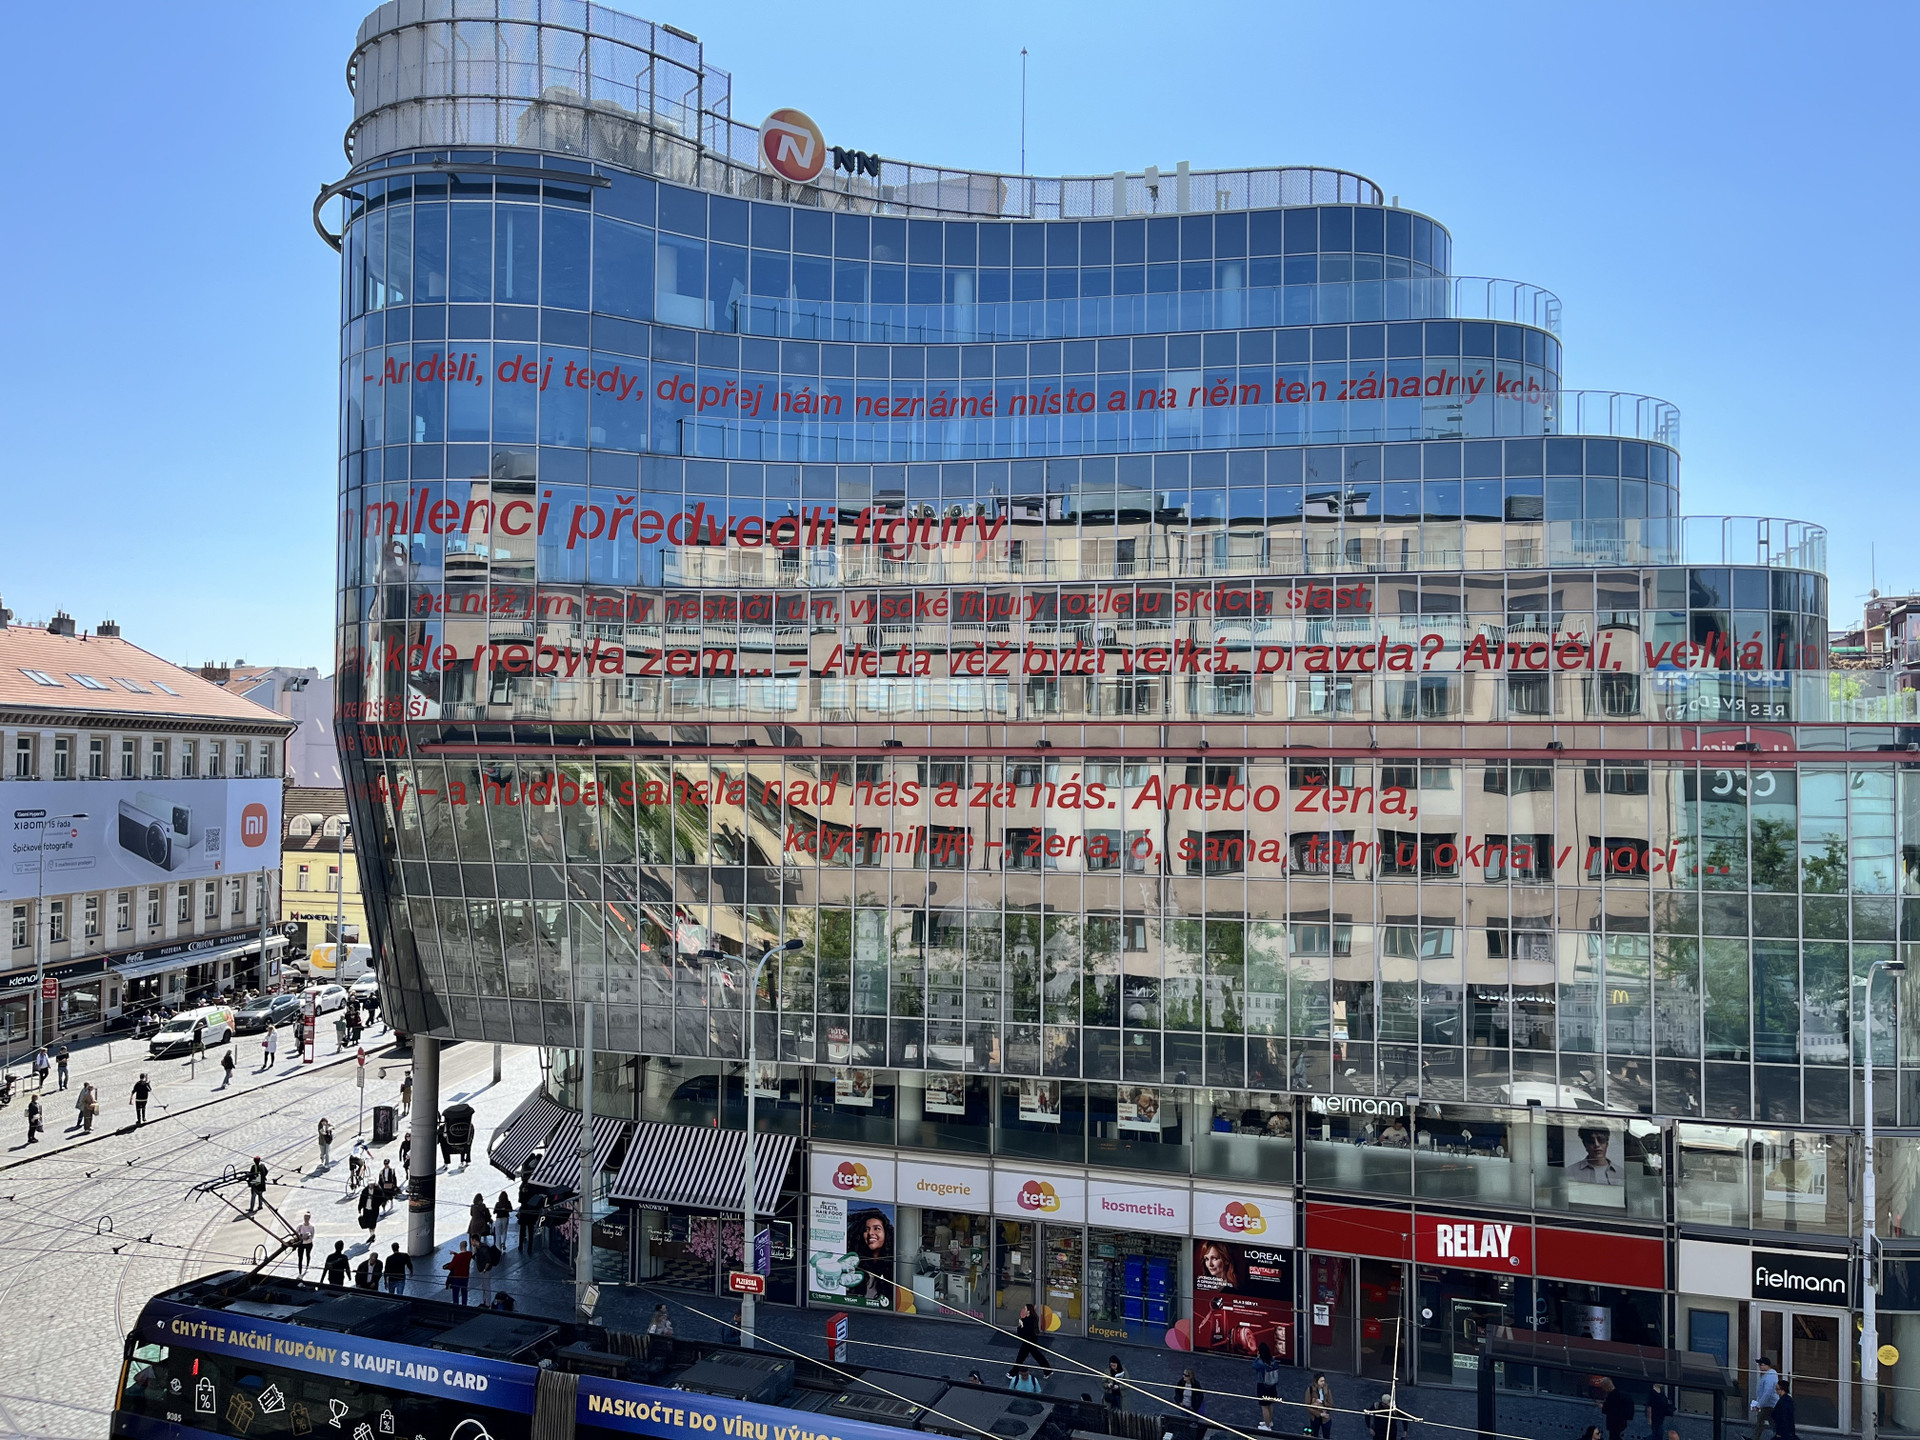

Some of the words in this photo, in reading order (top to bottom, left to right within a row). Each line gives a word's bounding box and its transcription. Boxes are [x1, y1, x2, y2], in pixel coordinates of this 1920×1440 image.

[833, 145, 879, 177] NN
[497, 354, 553, 391] dej
[564, 360, 644, 401] tedy,
[657, 374, 764, 417] dopřej
[772, 386, 843, 415] nám
[855, 389, 998, 417] neznámé
[1008, 386, 1096, 415] místo
[1107, 390, 1126, 412] a
[1136, 387, 1177, 410] na
[1188, 378, 1261, 408] něm
[1275, 377, 1327, 403] ten
[1337, 369, 1486, 405] záhadný
[363, 488, 552, 536] milenci
[566, 494, 836, 551] předvedli
[851, 505, 1015, 562] figury,
[416, 593, 450, 613] na
[523, 588, 574, 619] jim
[585, 593, 653, 623] tady
[663, 594, 779, 620] nestačil
[788, 599, 840, 624] um,
[850, 592, 949, 624] vysoké
[959, 591, 1045, 622] figury
[1054, 588, 1162, 614] rozletu
[1174, 584, 1273, 615] srdce,
[1285, 582, 1373, 613] slast,
[384, 635, 457, 672] kde
[472, 635, 624, 680] nebyla
[819, 643, 883, 677] Ale
[896, 643, 932, 676] ta
[945, 641, 1012, 675] věž
[1023, 640, 1106, 681] byla
[1121, 637, 1239, 674] velká,
[1254, 633, 1444, 679] pravda?
[1457, 632, 1622, 676] Anděli,
[1645, 631, 1764, 670] velká
[1776, 633, 1786, 670] i
[446, 781, 467, 805] a
[480, 773, 604, 806] hudba
[619, 772, 747, 806] sahala
[761, 772, 838, 807] nad
[849, 771, 921, 808] nás
[934, 781, 958, 807] a
[970, 782, 1016, 808] za
[1031, 773, 1116, 810] nás.
[1132, 774, 1280, 813] Anebo
[1294, 774, 1419, 820] žena,
[783, 822, 863, 860] když
[872, 825, 973, 864] miluje
[1024, 827, 1120, 863] žena,
[1177, 837, 1287, 869] sama,
[1307, 834, 1382, 866] tam
[1396, 844, 1418, 867] u
[1434, 836, 1532, 870] okna
[1553, 845, 1572, 870] v
[1584, 840, 1679, 873] noci
[838, 1171, 868, 1187] teta
[916, 1179, 971, 1196] drogerie
[638, 1203, 669, 1212] SANDWICH
[1022, 1190, 1056, 1207] teta
[1102, 1197, 1175, 1217] kosmetika
[1225, 1213, 1262, 1229] teta
[1436, 1224, 1513, 1258] RELAY
[1756, 1267, 1846, 1294] fielmann
[939, 1306, 985, 1319] kosika
[1088, 1325, 1128, 1339] drogerie
[171, 1319, 224, 1343] CHYŤTE
[228, 1330, 272, 1351] AKČNÍ
[275, 1339, 338, 1364] KUPÓNY
[340, 1351, 350, 1366] S
[353, 1353, 440, 1382] KAUFLAND
[443, 1367, 489, 1391] CARD
[588, 1394, 684, 1427] NASKOČTE
[689, 1412, 716, 1431] DO
[722, 1415, 768, 1440] VÍRU
[774, 1424, 842, 1440] VÝH
